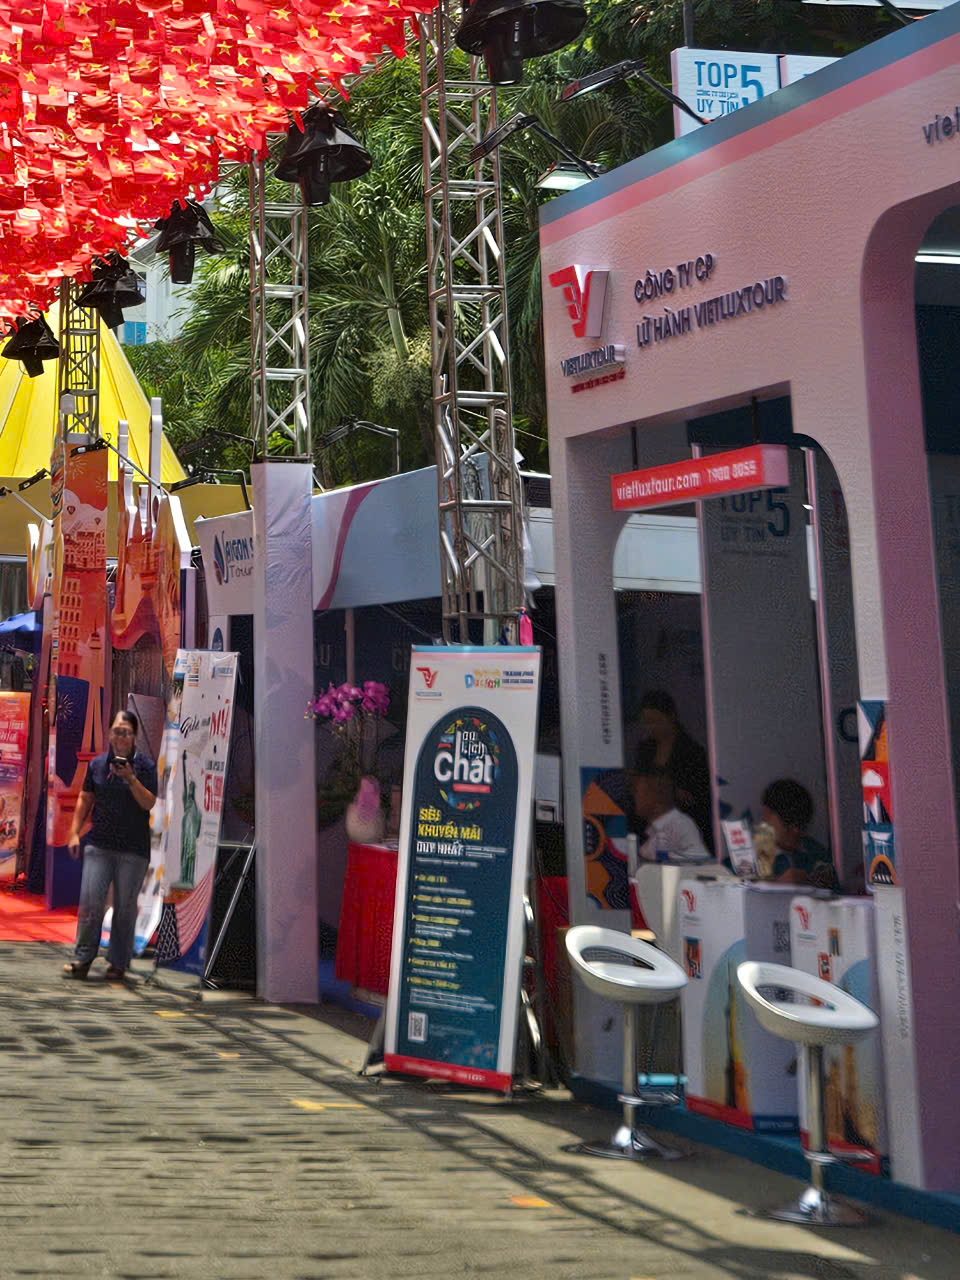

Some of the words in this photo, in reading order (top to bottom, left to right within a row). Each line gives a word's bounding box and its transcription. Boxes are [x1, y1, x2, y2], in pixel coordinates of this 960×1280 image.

[694, 61, 738, 89] TOP
[740, 64, 764, 107] 5
[696, 98, 714, 114] UY
[634, 268, 674, 304] CÔNG
[676, 260, 694, 289] TY
[695, 253, 717, 282] CP
[654, 306, 691, 342] HÀNH
[693, 275, 787, 329] VIETLUXTOUR
